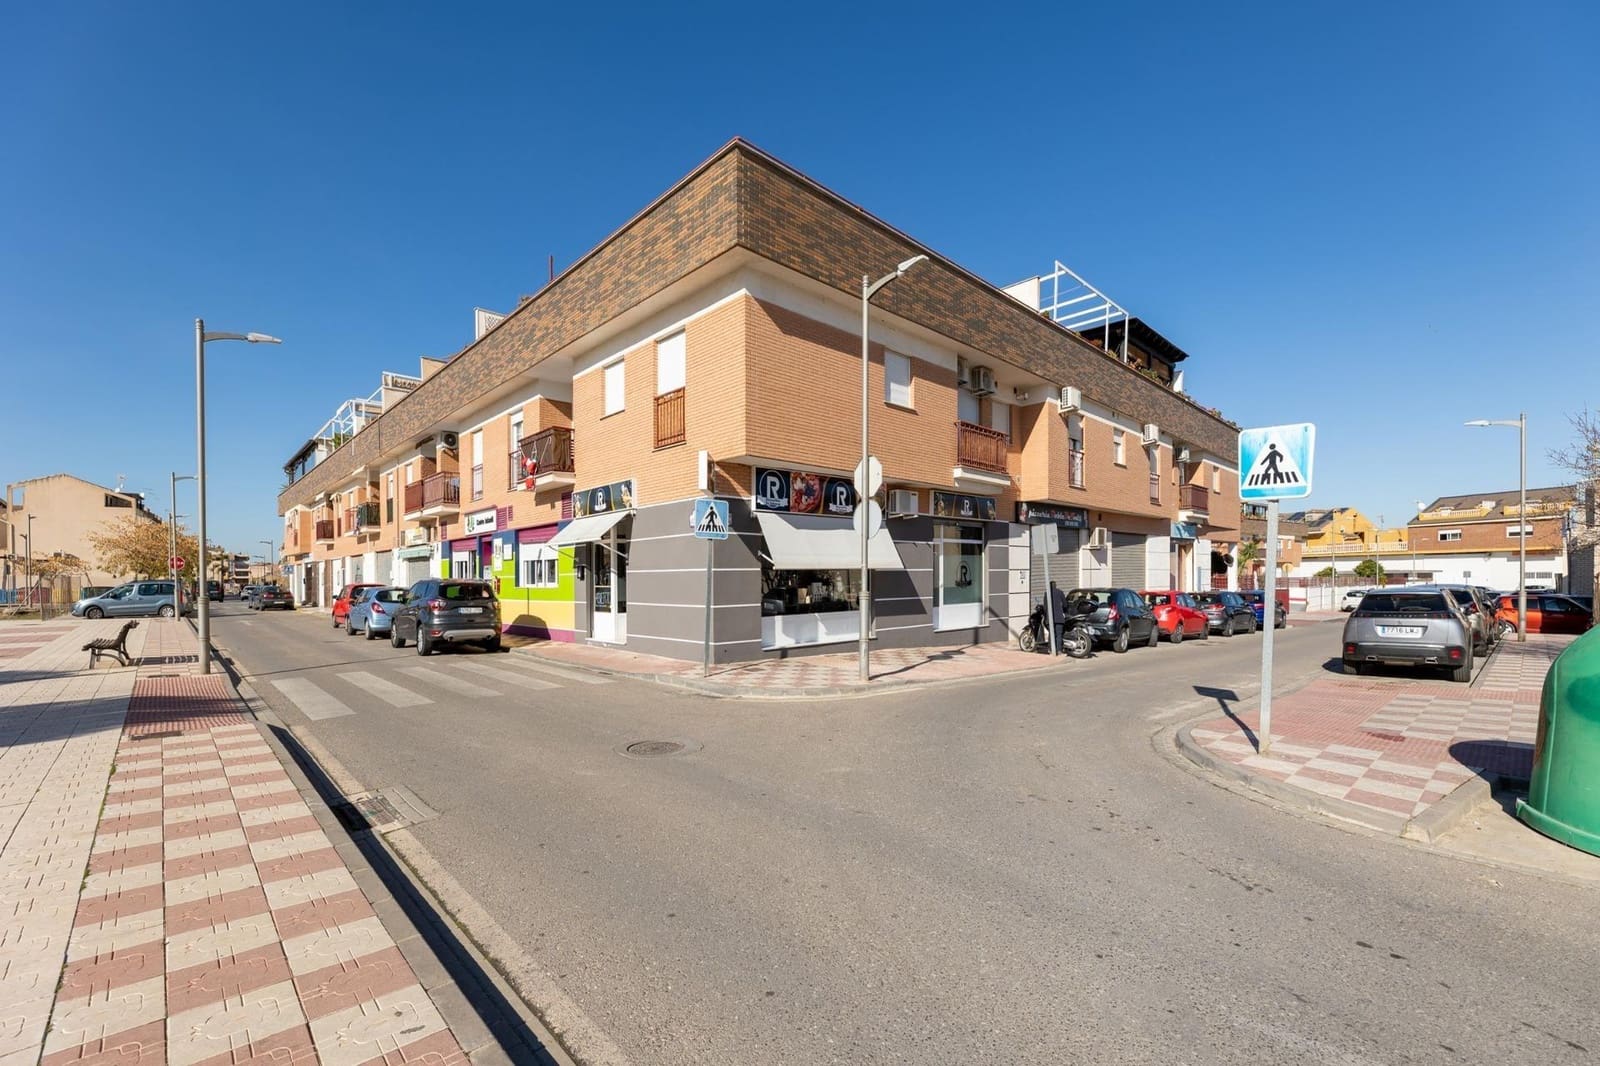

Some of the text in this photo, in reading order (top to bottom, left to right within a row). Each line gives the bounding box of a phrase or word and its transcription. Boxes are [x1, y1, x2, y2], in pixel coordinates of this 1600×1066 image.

[766, 475, 780, 499] R
[836, 486, 847, 506] R
[597, 492, 603, 505] R
[963, 499, 970, 513] R
[960, 565, 968, 583] R
